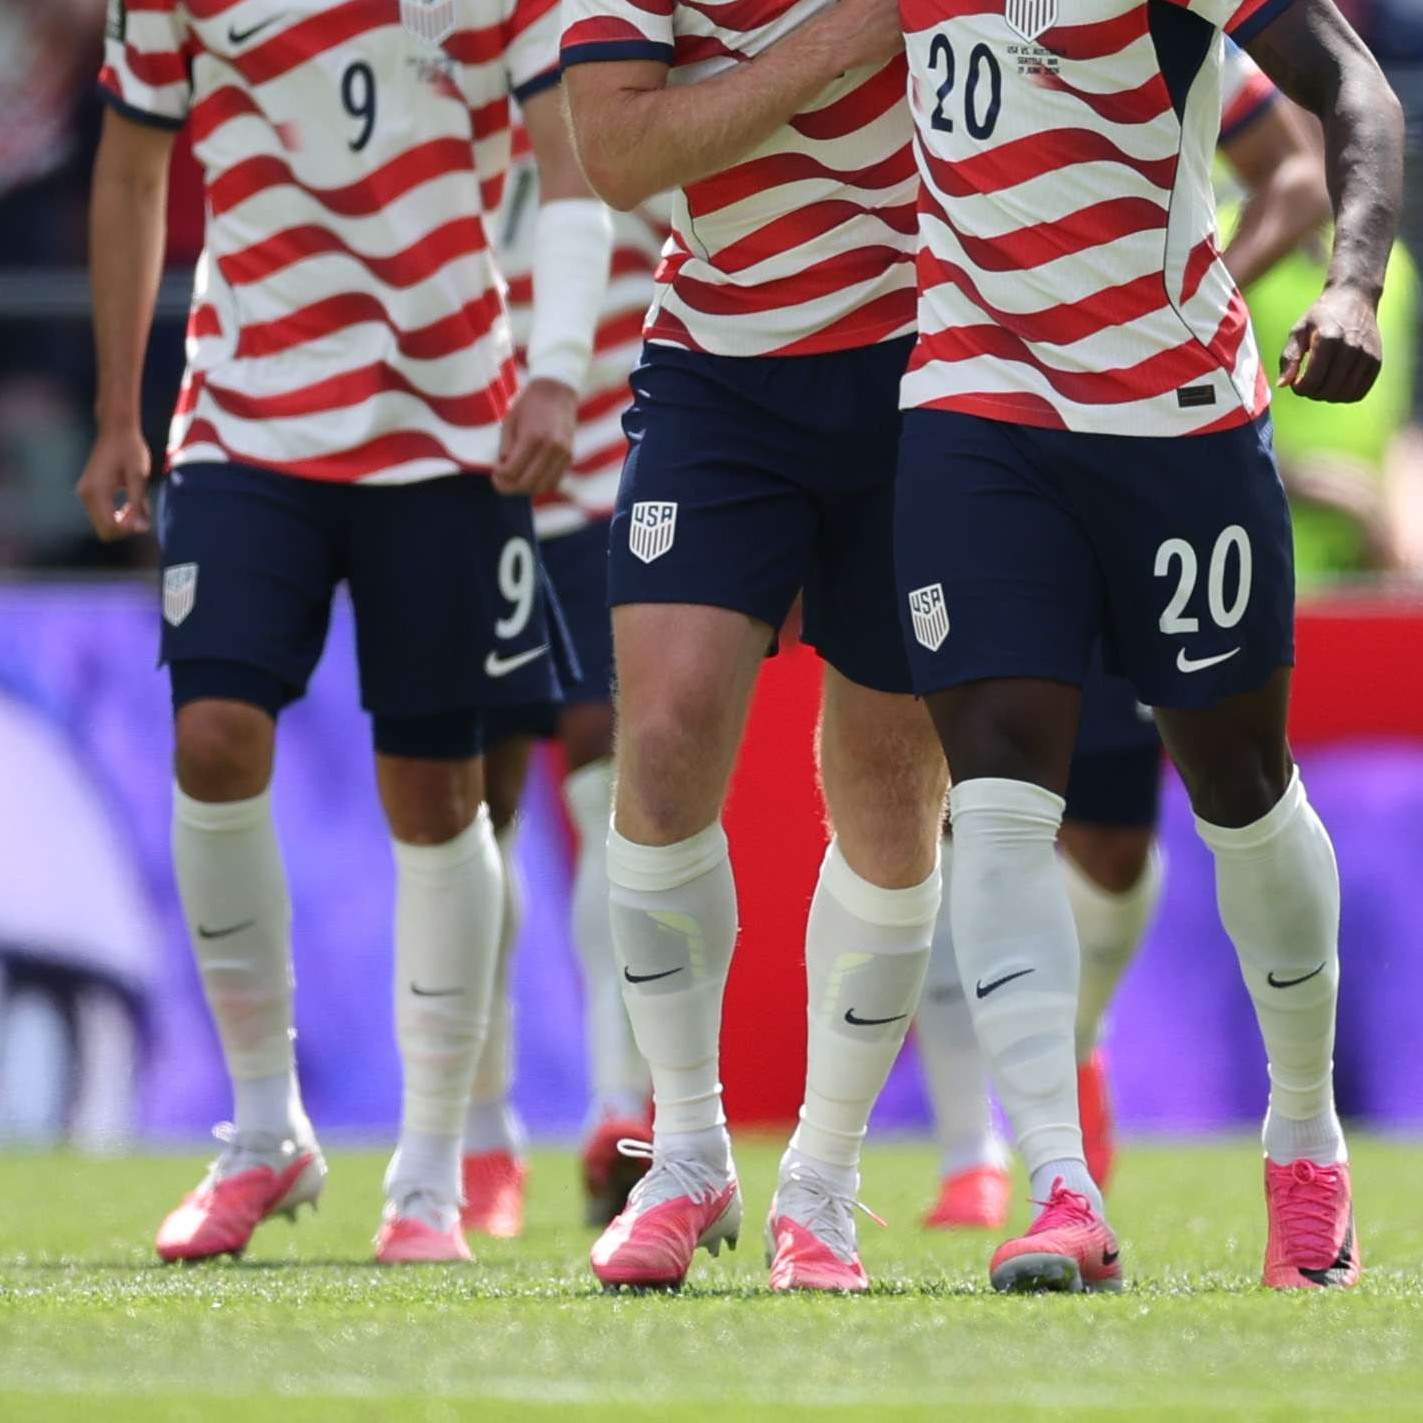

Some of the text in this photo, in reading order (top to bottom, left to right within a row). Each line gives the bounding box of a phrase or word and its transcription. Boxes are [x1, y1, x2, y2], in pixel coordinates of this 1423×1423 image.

[341, 61, 375, 152] 9
[928, 33, 1001, 140] 20
[635, 505, 673, 527] USA
[495, 536, 534, 639] 9
[911, 588, 941, 615] USA
[1154, 525, 1252, 634] 20
